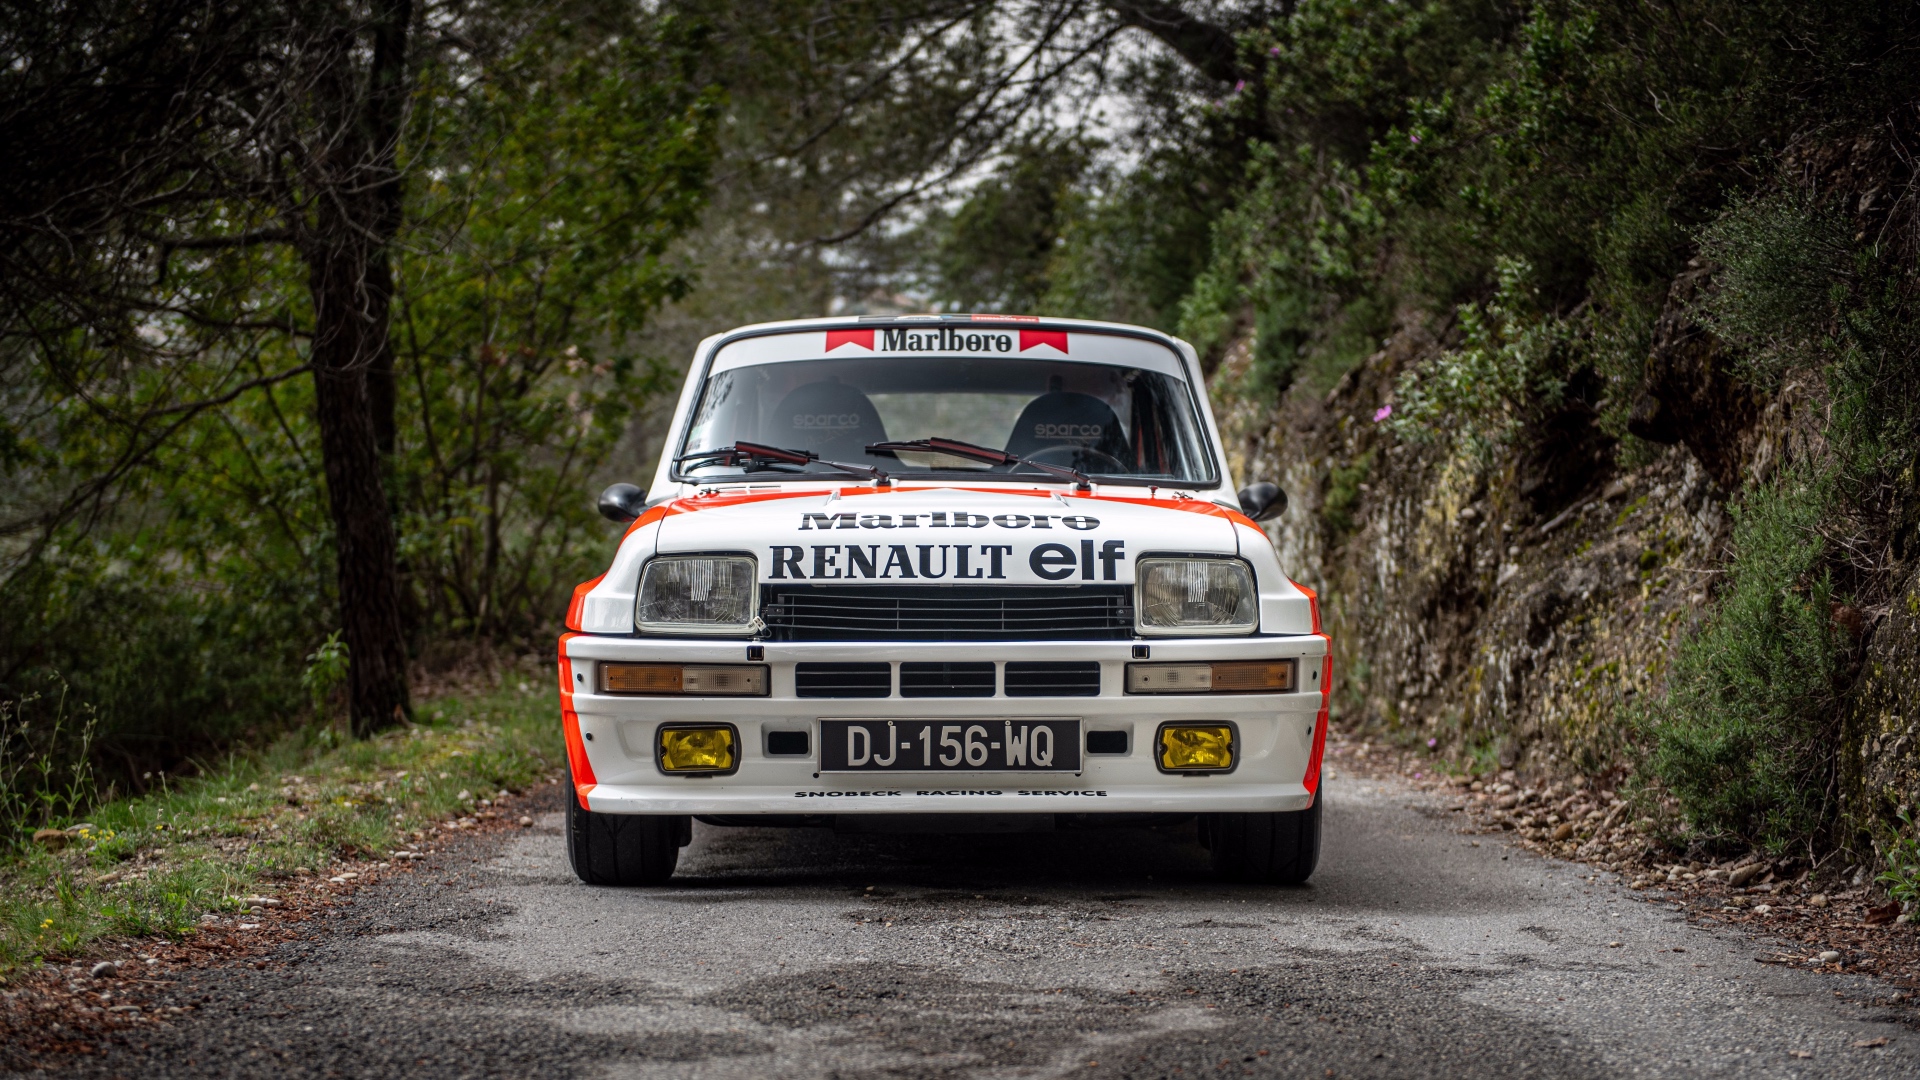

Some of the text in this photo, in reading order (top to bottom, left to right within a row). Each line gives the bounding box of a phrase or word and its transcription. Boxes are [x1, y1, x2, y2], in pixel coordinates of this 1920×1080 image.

[881, 328, 1012, 353] Marlboro
[793, 413, 860, 429] sparco
[1034, 423, 1102, 438] sparco
[798, 511, 1101, 531] Marlboro
[768, 539, 1126, 581] RENAULT elf
[847, 724, 1054, 767] DJ-156-WQ
[1017, 789, 1108, 797] SERVICE
